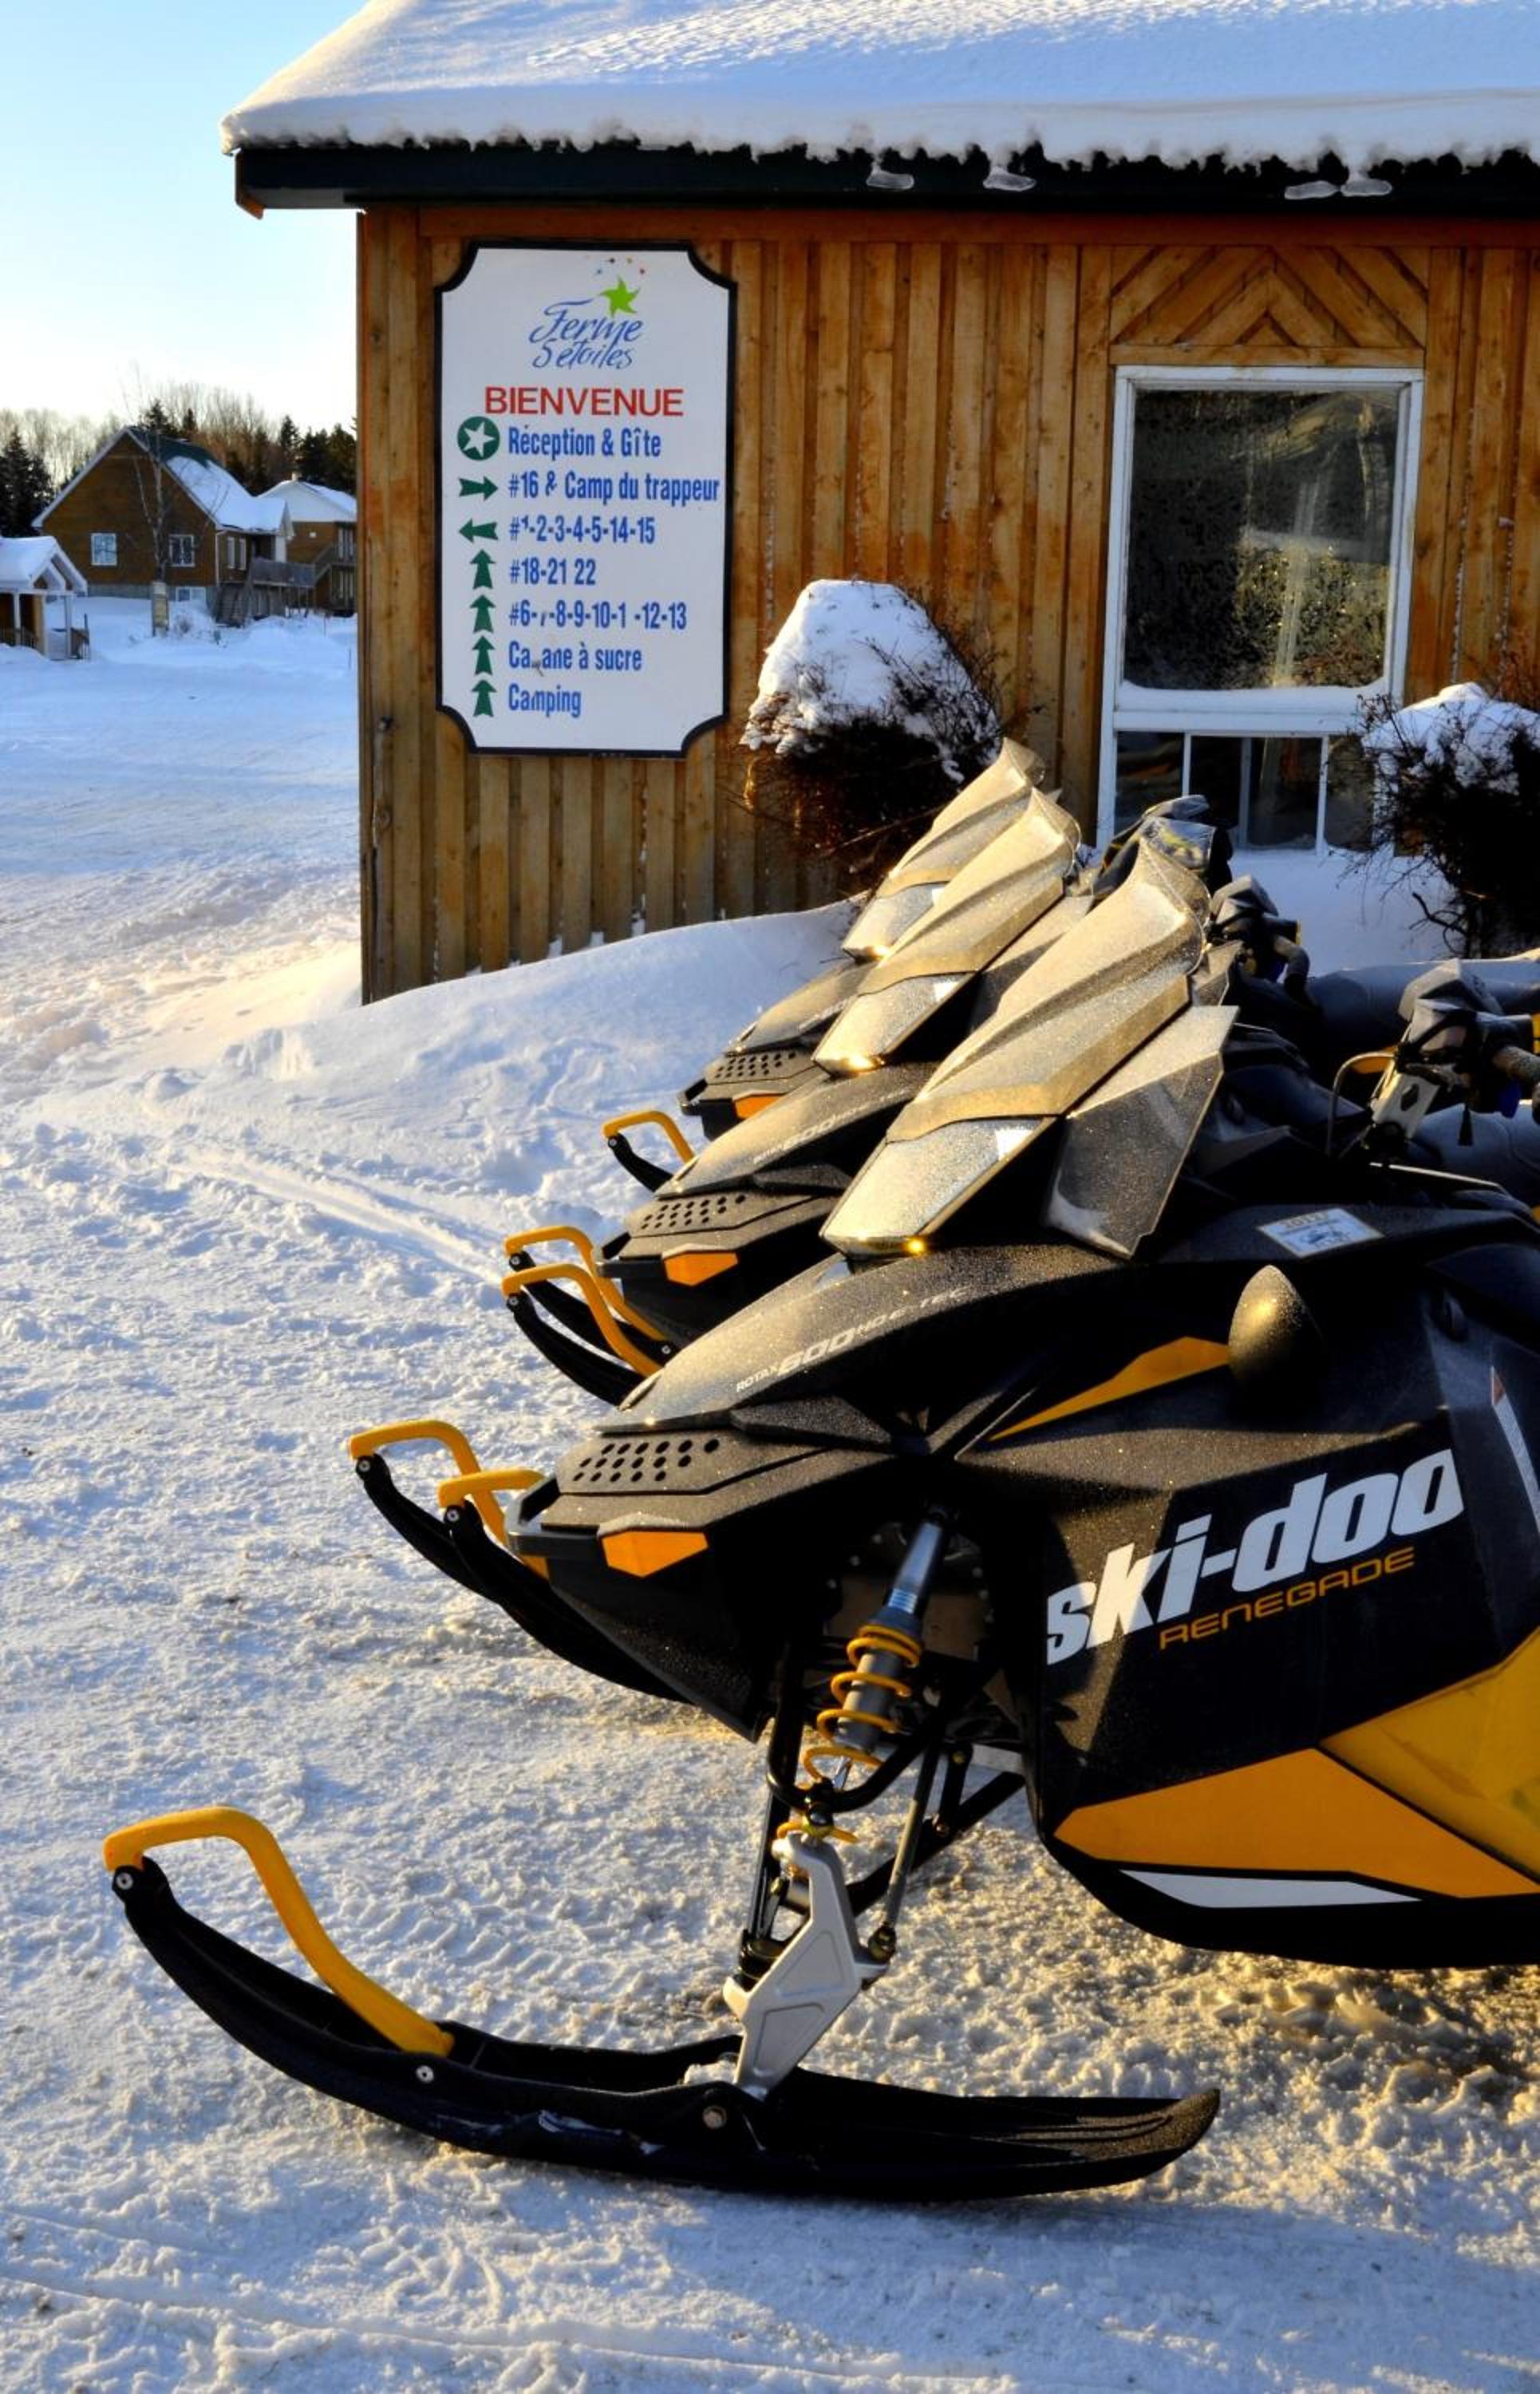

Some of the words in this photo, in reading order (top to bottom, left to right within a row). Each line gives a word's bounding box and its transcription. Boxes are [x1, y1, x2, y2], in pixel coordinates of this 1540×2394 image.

[529, 298, 643, 346] Ferme
[532, 338, 557, 368] 5
[485, 387, 684, 417] BIENVENUE
[508, 425, 595, 460] Réception
[602, 428, 614, 456] &
[622, 428, 661, 457] Gîte
[508, 471, 539, 498] #16
[565, 471, 614, 505] Camp
[619, 472, 639, 501] du
[646, 474, 720, 507] trappeur
[579, 642, 589, 670] à
[595, 648, 642, 671] sucre
[508, 684, 581, 717] Camping
[1047, 1449, 1464, 1666] ski-doo
[1159, 1546, 1416, 1651] RENEGADE
